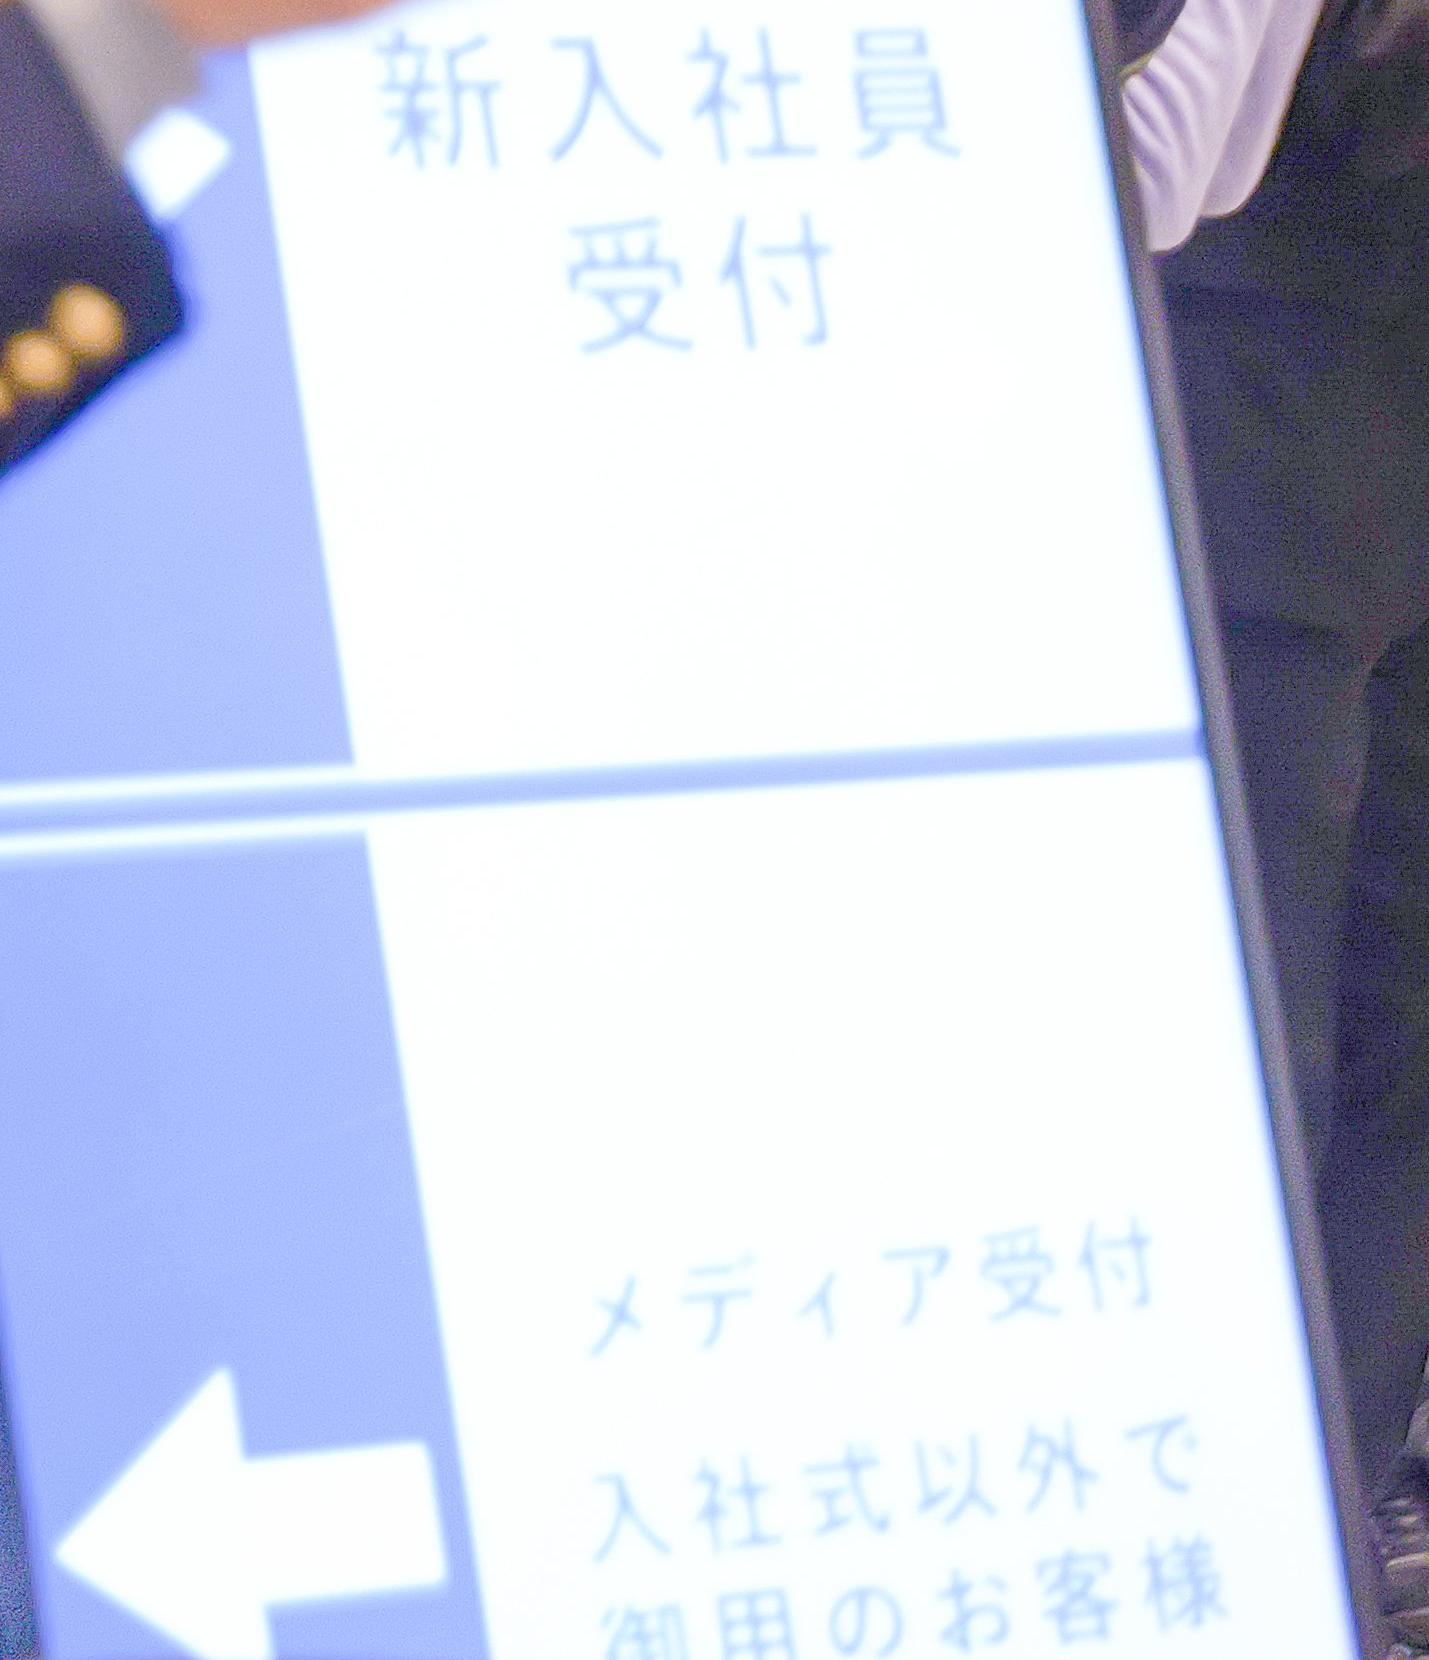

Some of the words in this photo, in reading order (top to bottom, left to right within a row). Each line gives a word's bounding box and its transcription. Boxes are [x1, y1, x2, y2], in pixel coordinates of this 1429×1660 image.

[376, 29, 961, 168] 新入社員
[568, 214, 832, 352] 受付
[590, 1217, 1152, 1355] メディア受付
[592, 1412, 1200, 1561] 入社式以外で
[601, 1534, 1227, 1660] 御用のお客様
